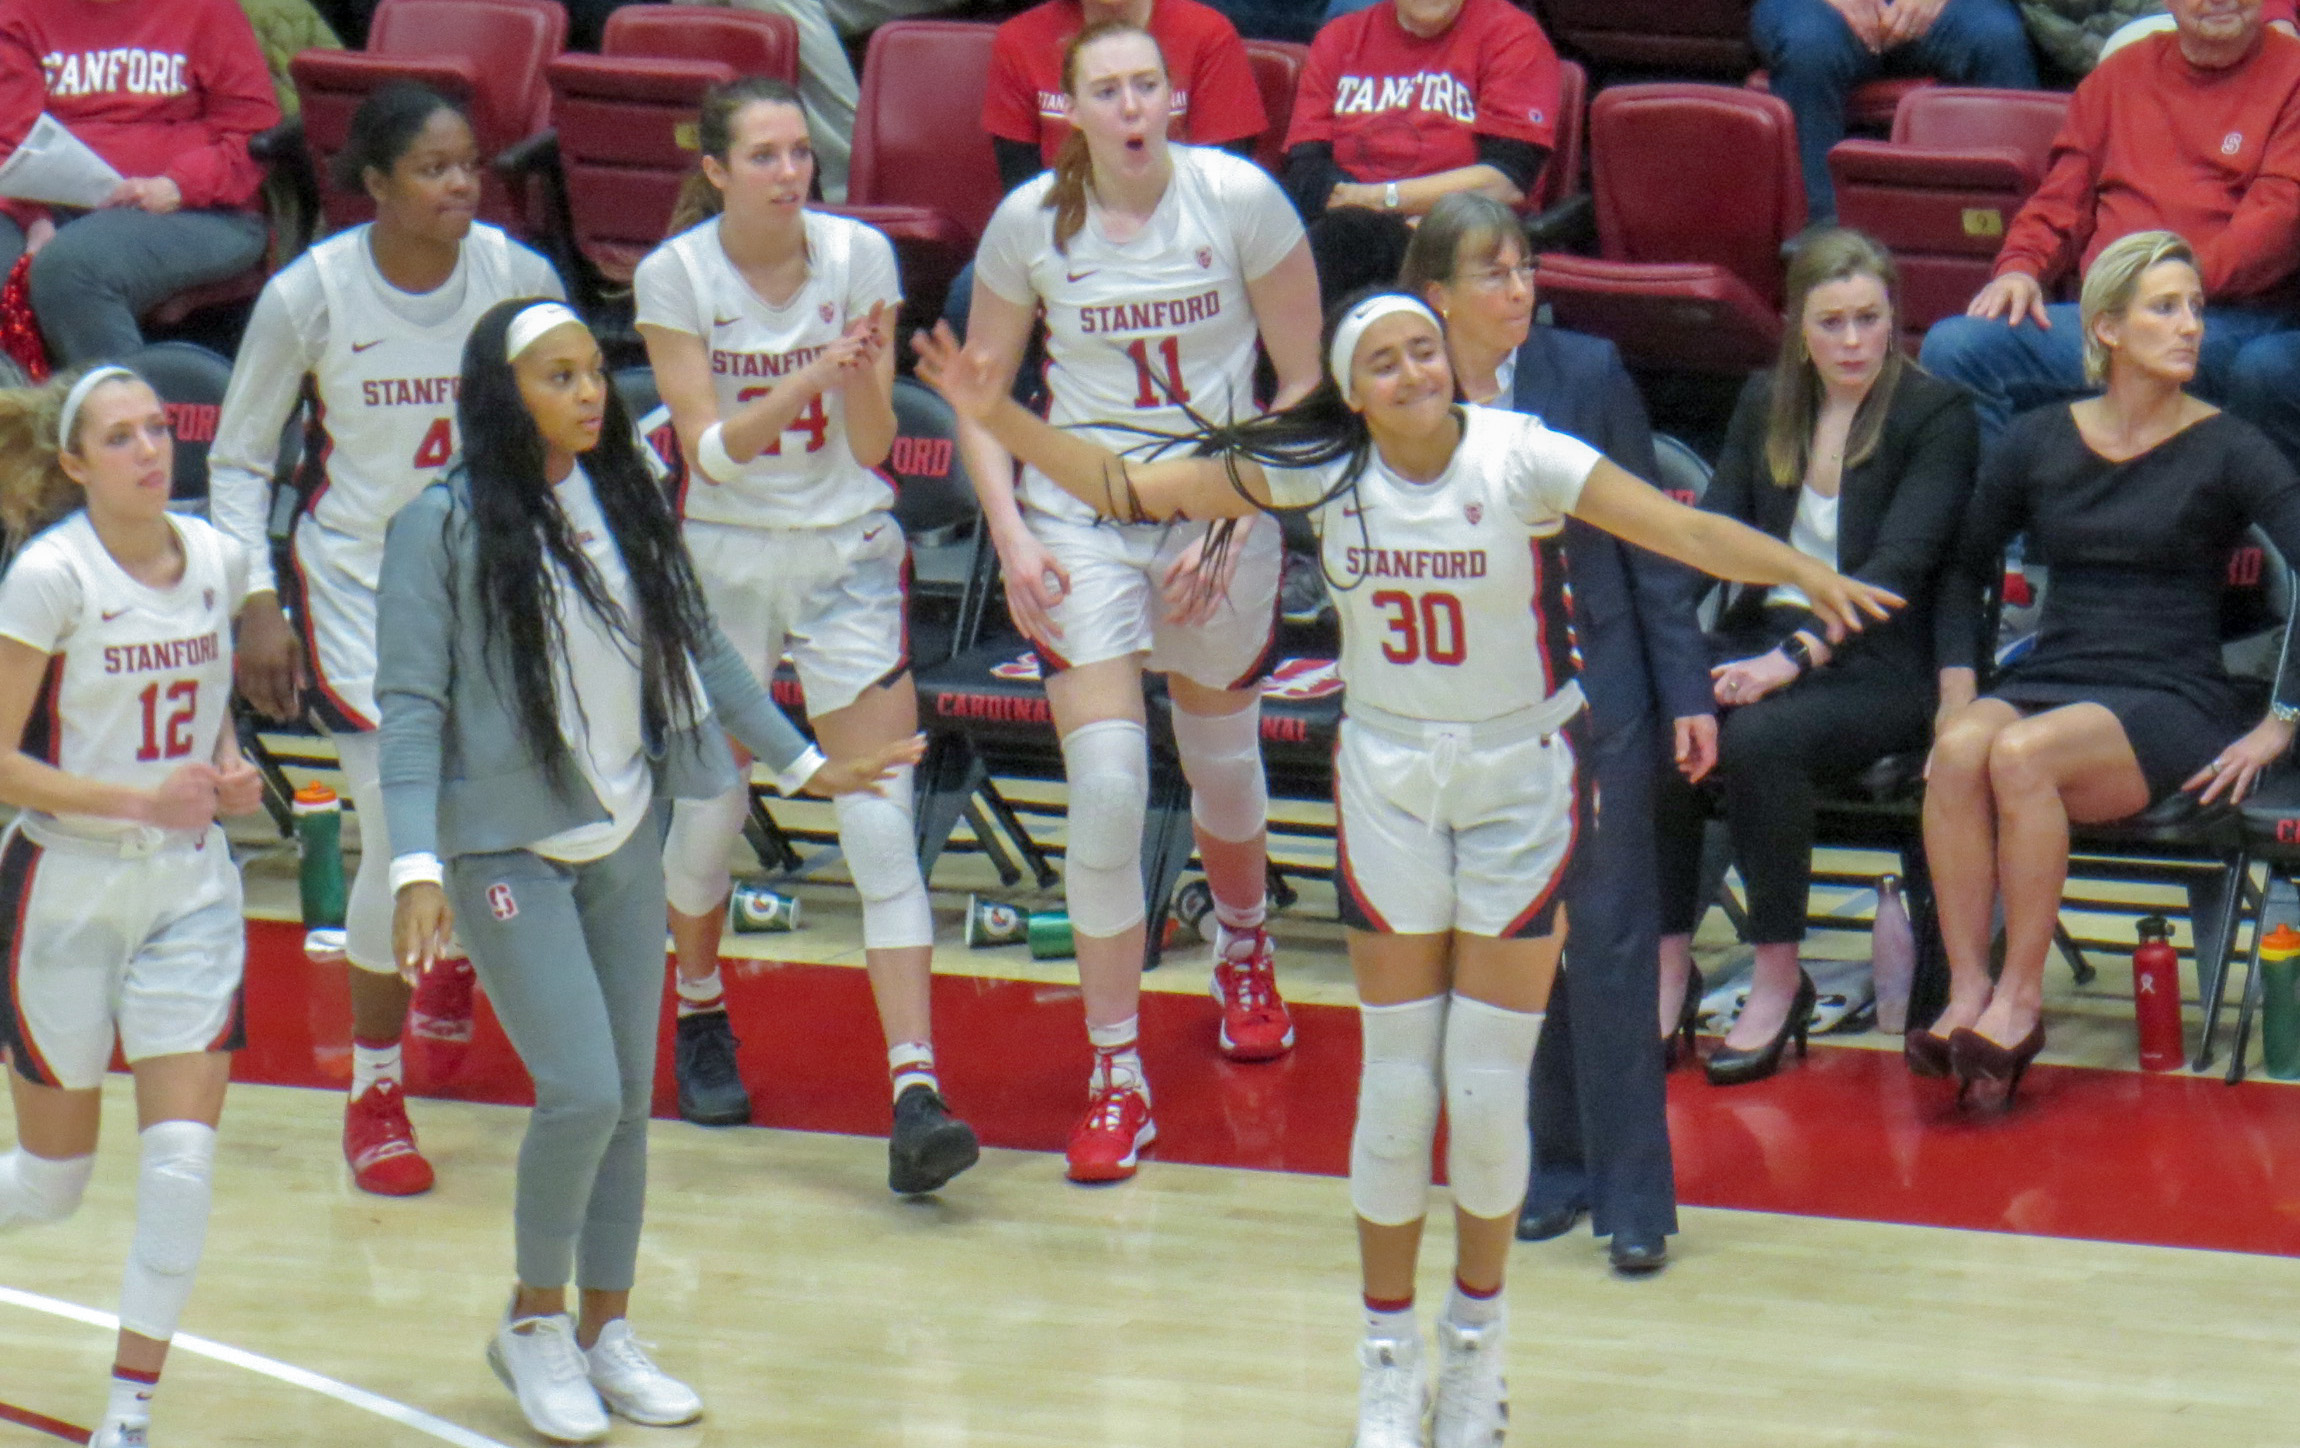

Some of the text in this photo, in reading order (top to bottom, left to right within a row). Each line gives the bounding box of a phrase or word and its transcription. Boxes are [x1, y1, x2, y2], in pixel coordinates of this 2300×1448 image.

[1080, 289, 1221, 333] STANFORD
[1126, 335, 1191, 408] 11
[413, 417, 453, 469] 4
[1346, 547, 1487, 579] STANFORD
[103, 631, 219, 675] STANFORD
[1372, 589, 1467, 667] 30
[136, 679, 199, 761] 12
